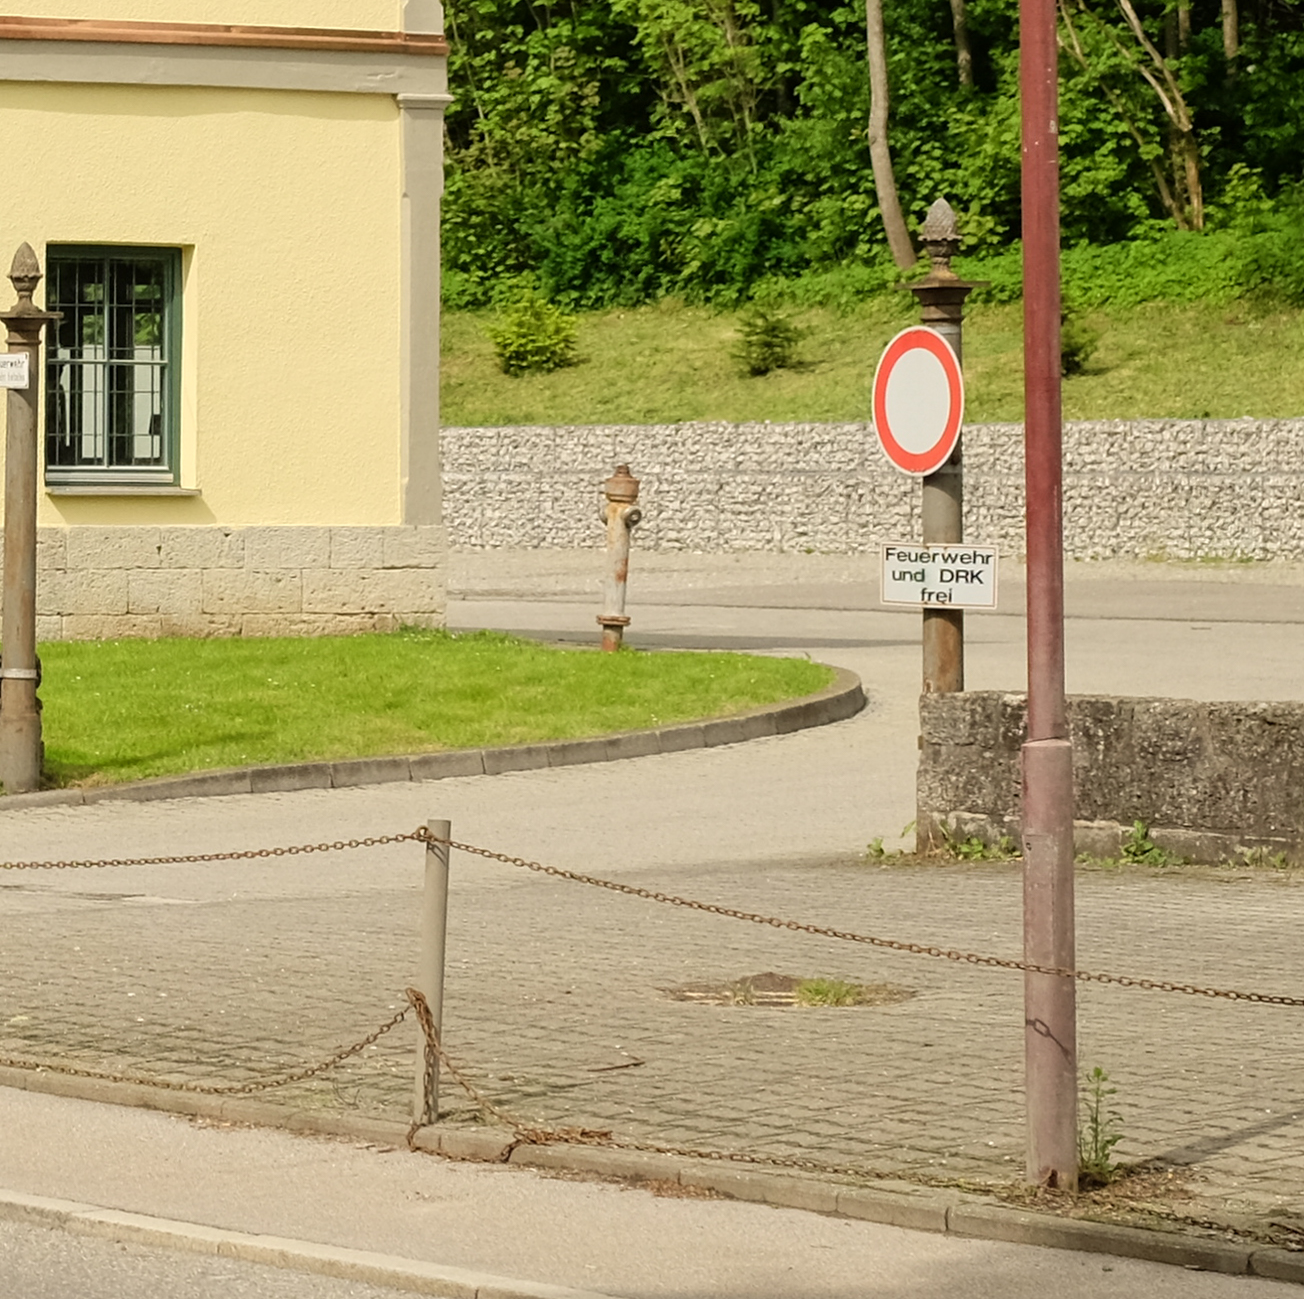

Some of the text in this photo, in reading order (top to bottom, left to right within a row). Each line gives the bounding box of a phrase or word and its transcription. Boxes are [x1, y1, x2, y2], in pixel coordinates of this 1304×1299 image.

[885, 547, 993, 565] Feuerwehr
[892, 568, 984, 584] und DRK
[921, 587, 953, 603] frei
